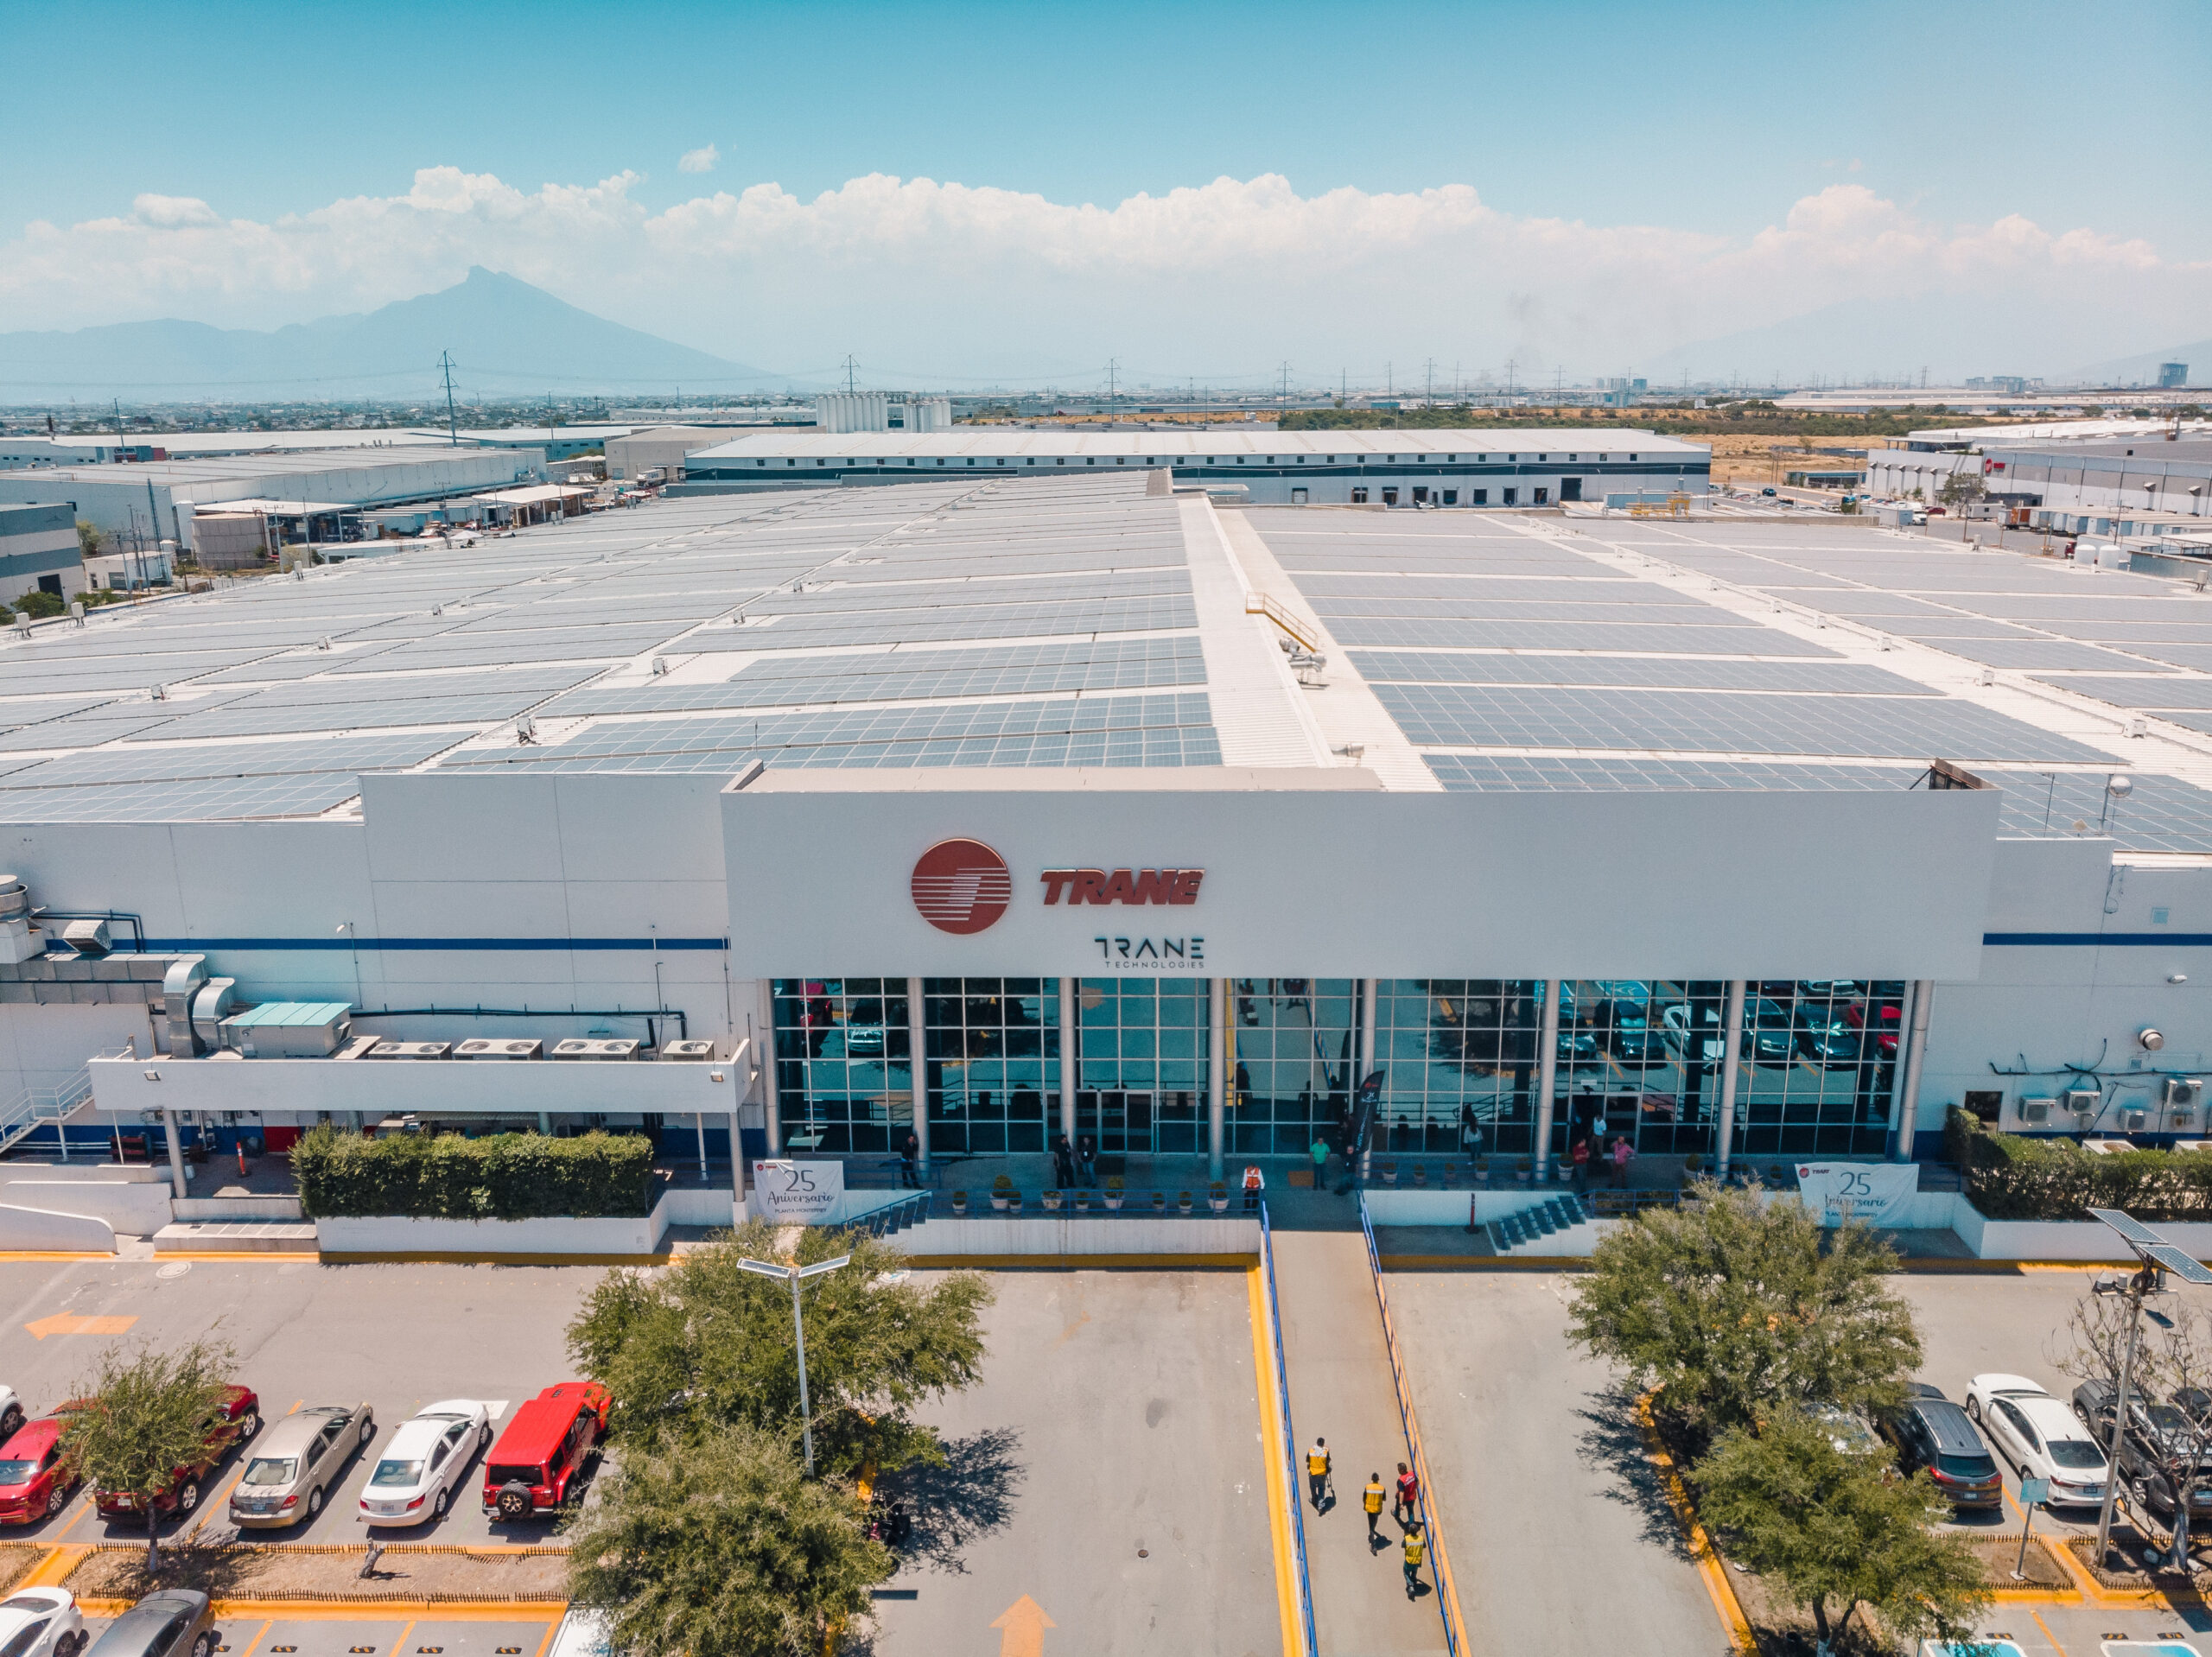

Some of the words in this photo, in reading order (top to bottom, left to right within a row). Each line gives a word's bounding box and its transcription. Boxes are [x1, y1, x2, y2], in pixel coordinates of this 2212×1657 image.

[1040, 868, 1205, 905] TRANE
[1094, 937, 1205, 959] TRANE
[784, 1170, 816, 1192] 25
[1839, 1171, 1872, 1196] 25
[767, 1191, 835, 1205] Aniversario
